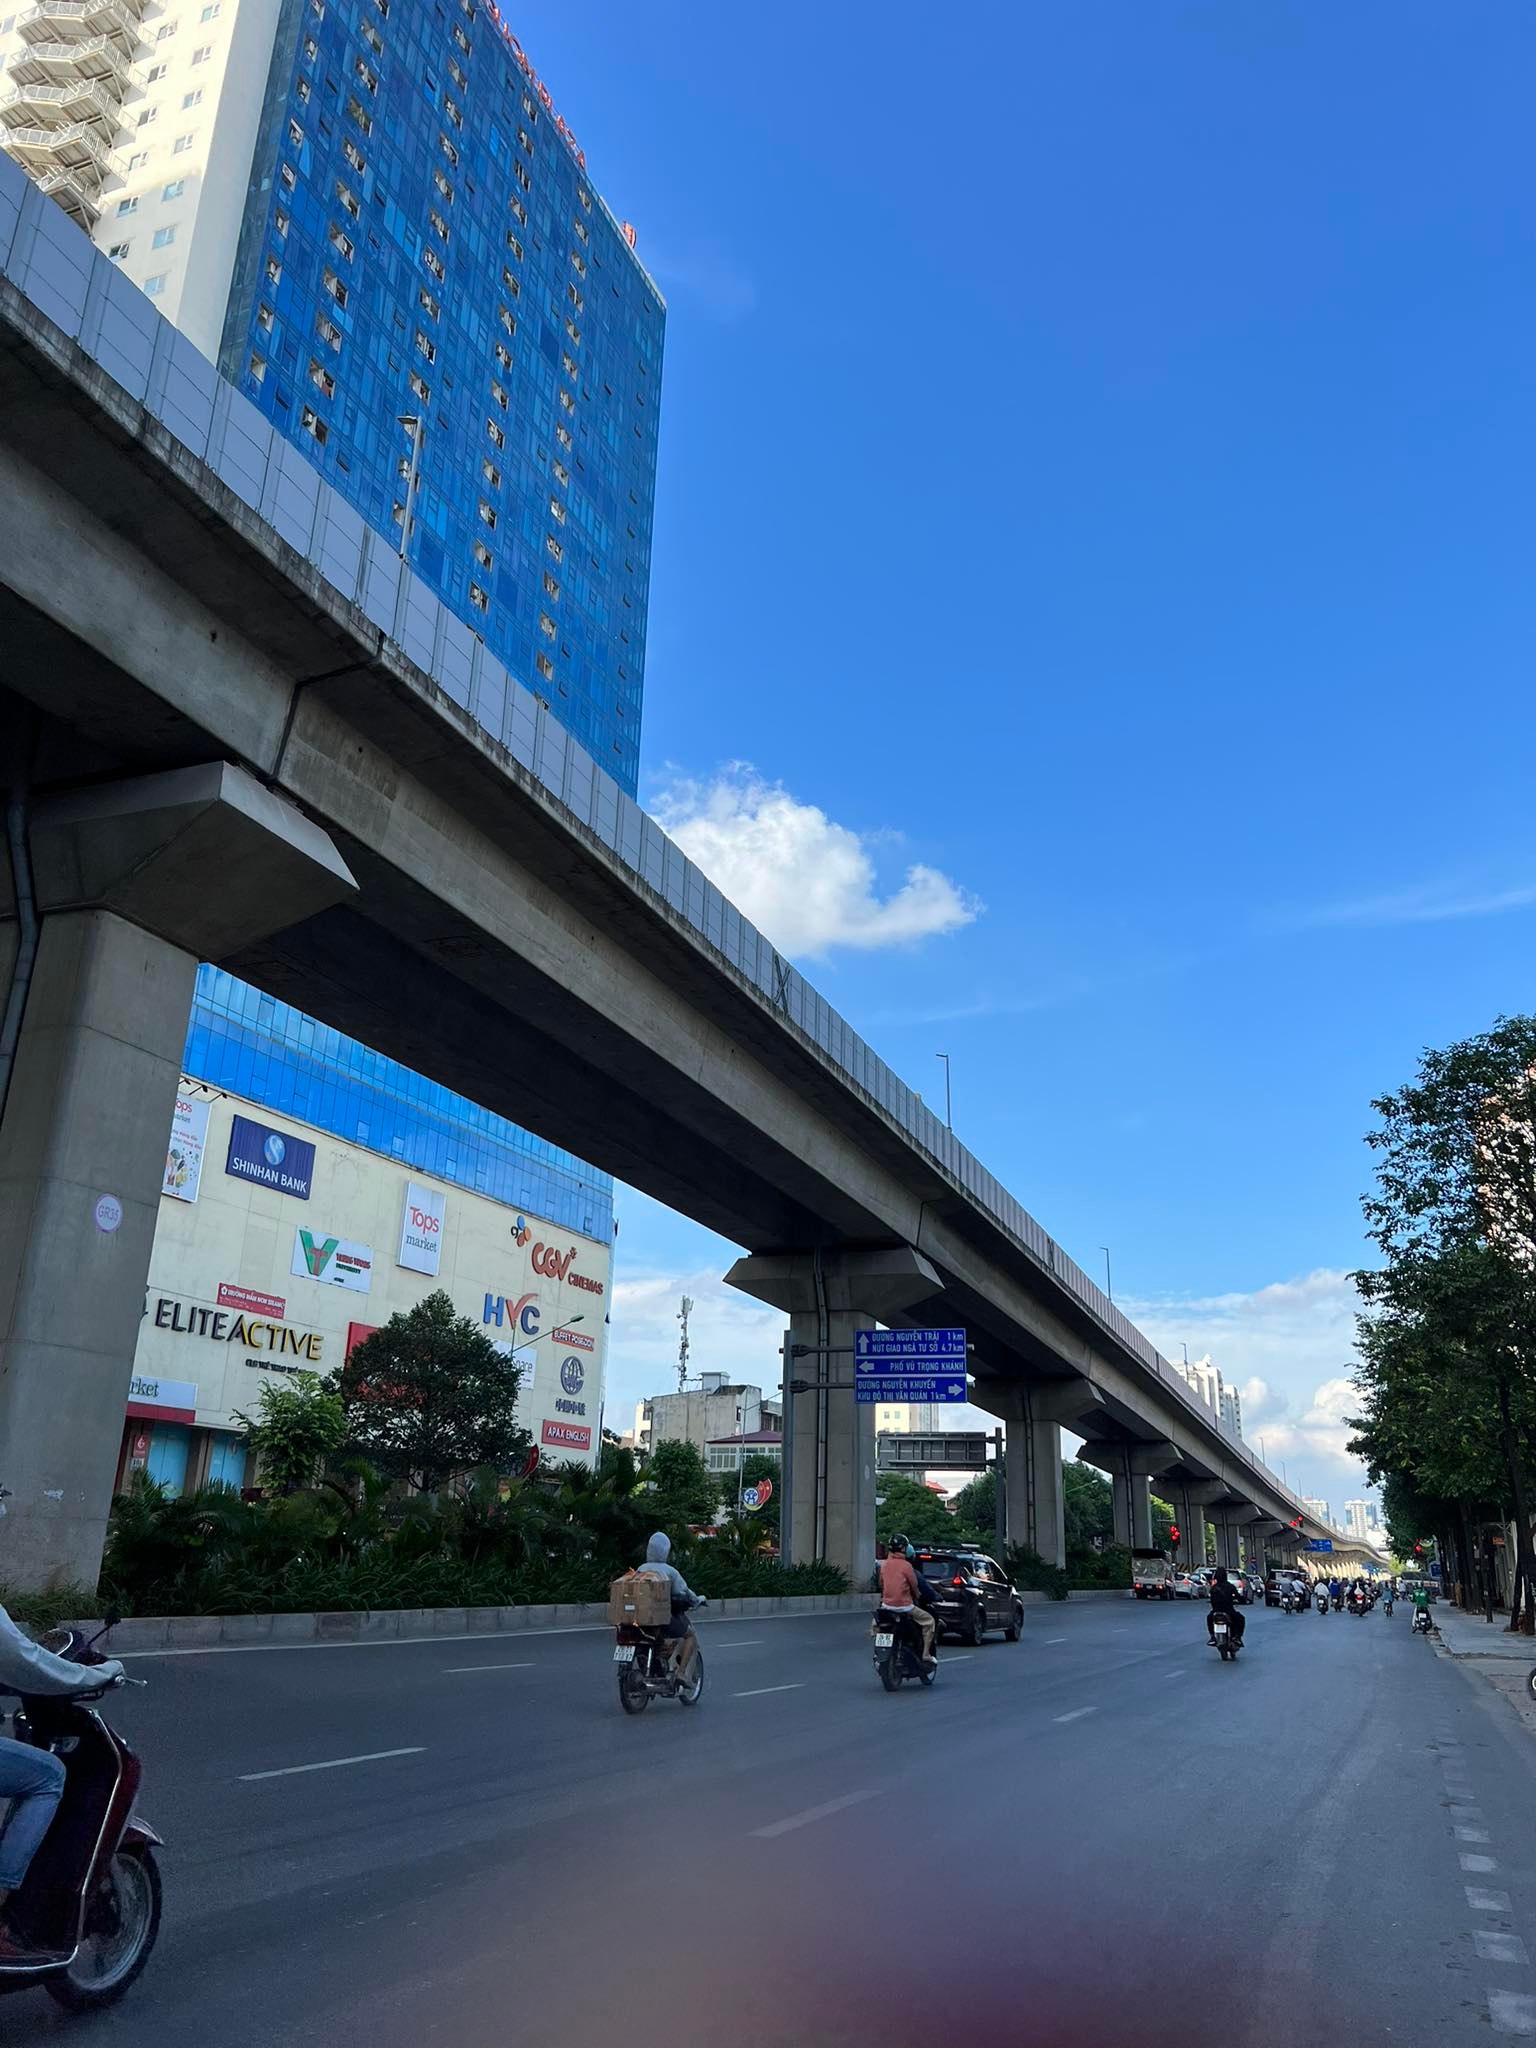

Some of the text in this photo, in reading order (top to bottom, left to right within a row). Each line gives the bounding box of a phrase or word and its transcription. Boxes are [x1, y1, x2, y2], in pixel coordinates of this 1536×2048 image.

[232, 1157, 307, 1193] SHINHAN BANK
[410, 1206, 440, 1235] Tops
[406, 1234, 437, 1253] market
[532, 1242, 572, 1281] CGV
[568, 1272, 604, 1295] CINEMAS
[554, 1330, 572, 1342] BUFFET
[952, 1332, 964, 1340] km
[885, 1343, 901, 1352] GIAO
[941, 1344, 952, 1352] 4.7
[953, 1343, 964, 1352] km
[858, 1392, 871, 1400] KHU
[935, 1392, 947, 1400] km
[547, 1426, 590, 1443] APAX ENGLISH
